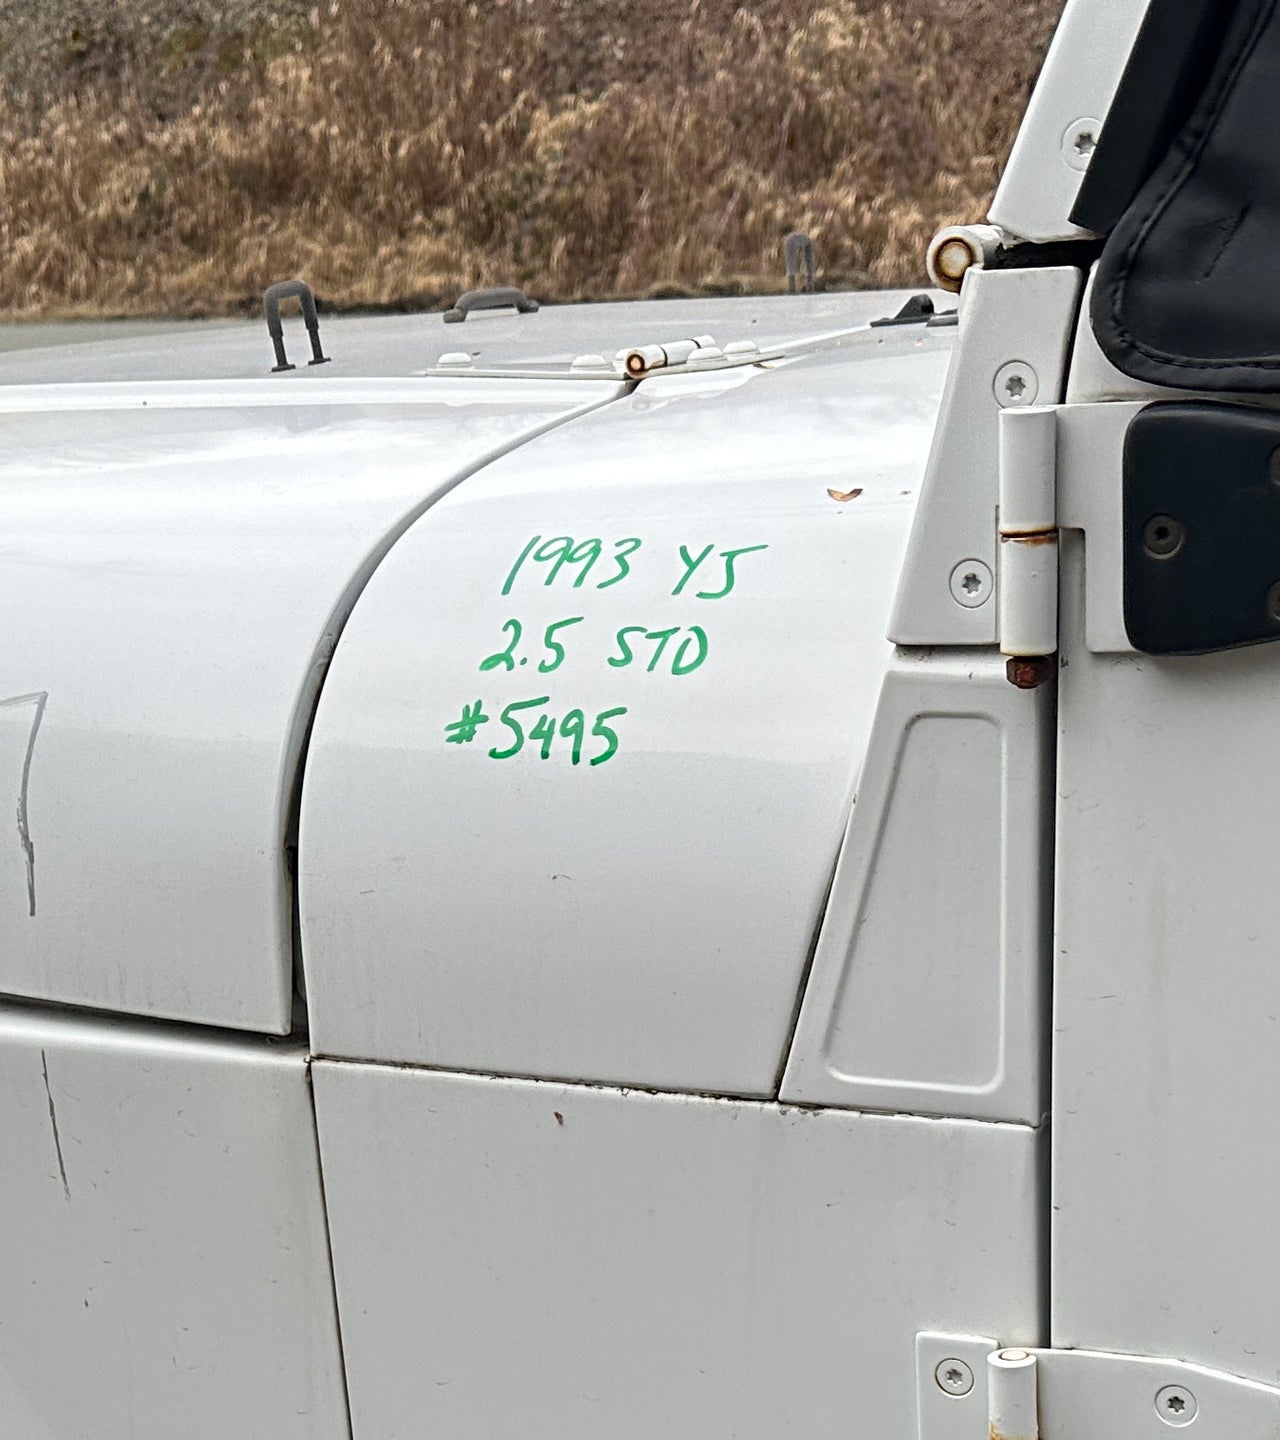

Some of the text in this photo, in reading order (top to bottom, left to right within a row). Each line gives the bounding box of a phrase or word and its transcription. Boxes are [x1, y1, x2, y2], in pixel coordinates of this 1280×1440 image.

[501, 535, 769, 600] 1993 YJ
[478, 616, 709, 676] 2.5 STD
[444, 695, 628, 767] #5495
